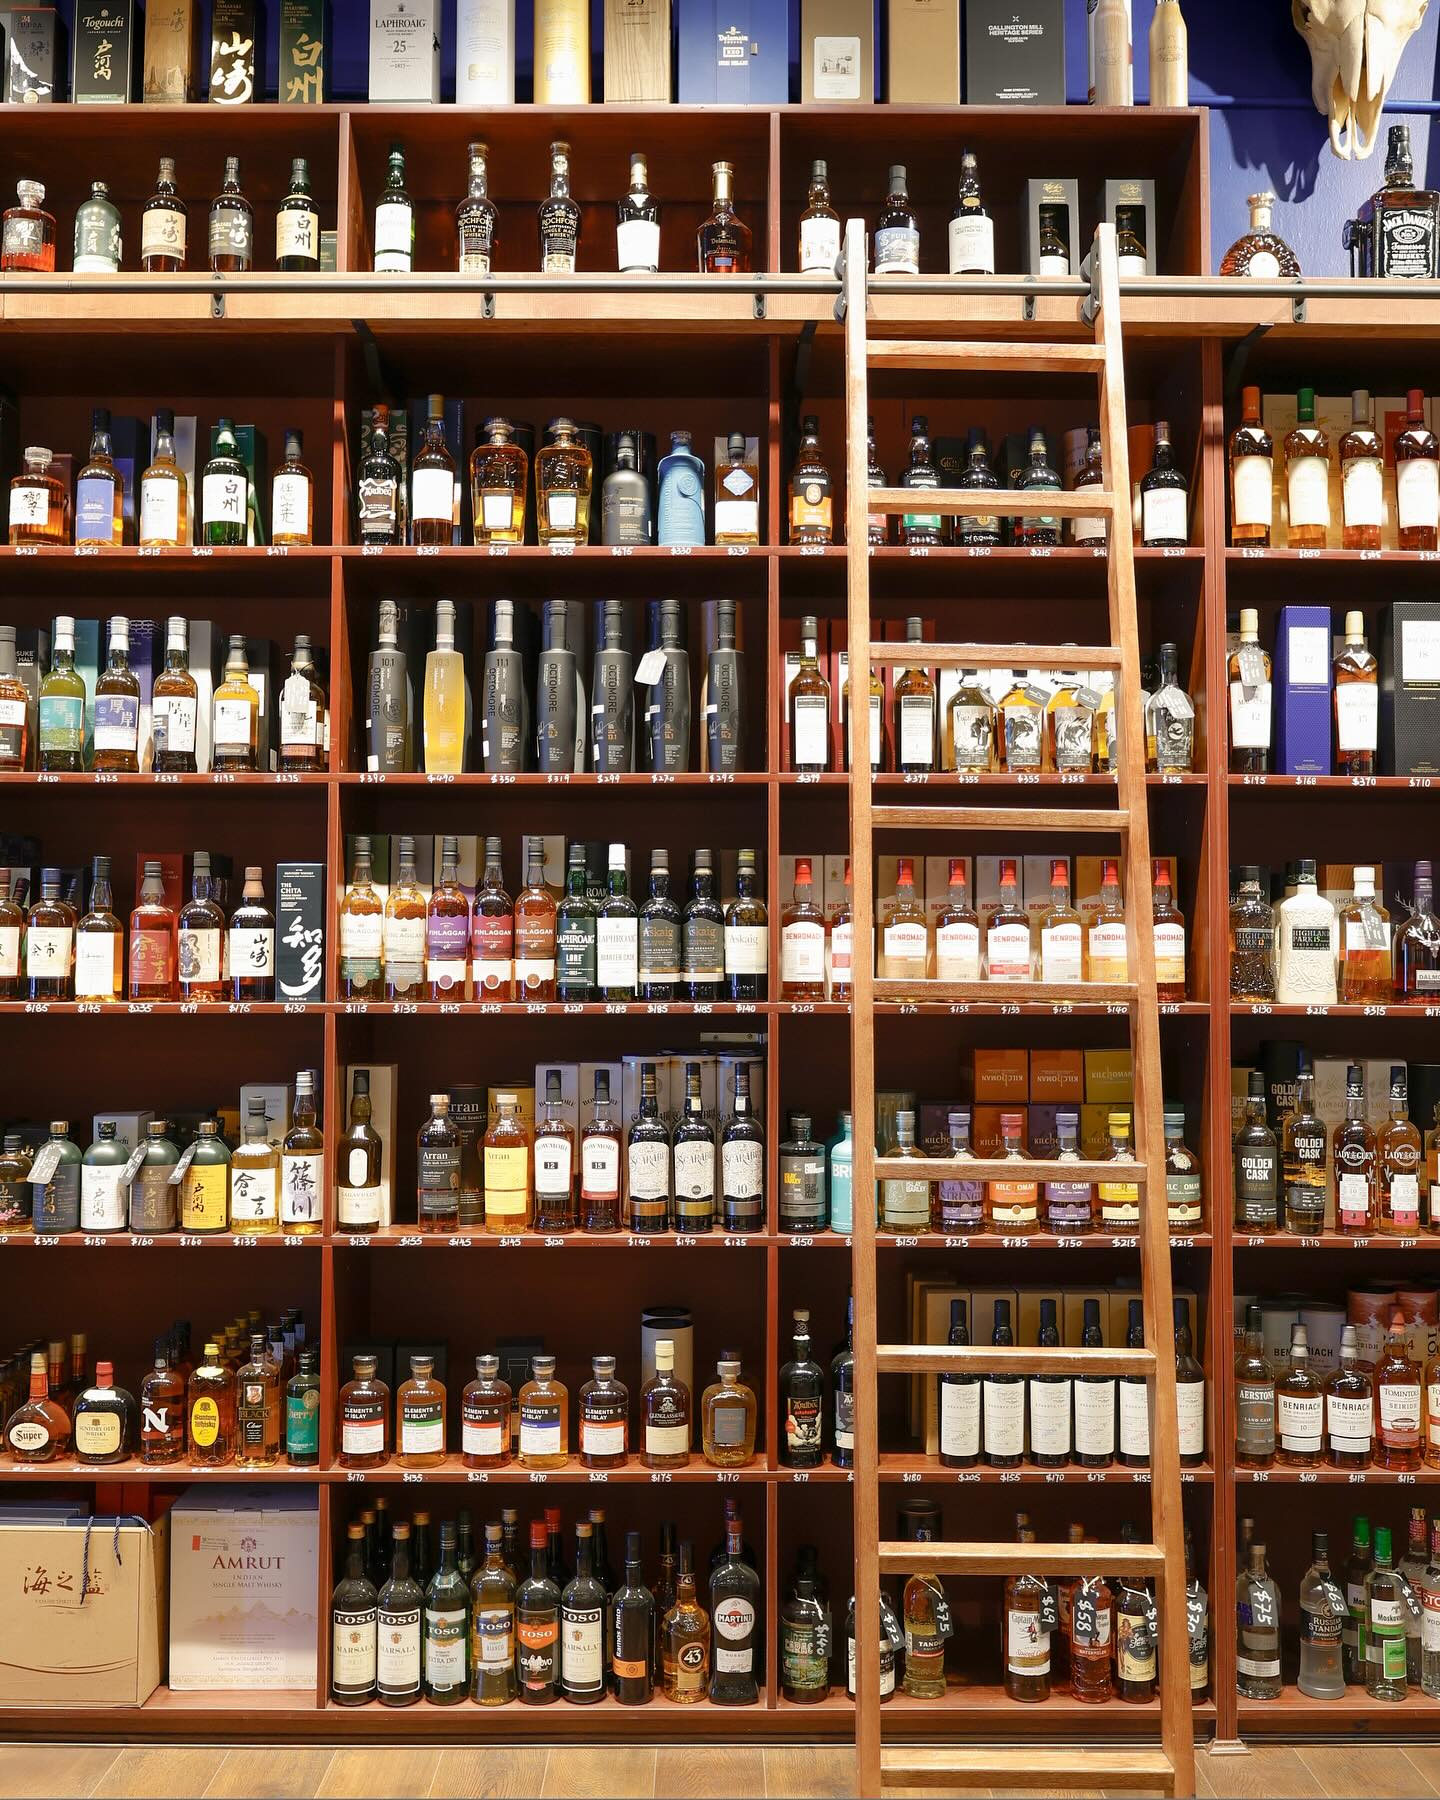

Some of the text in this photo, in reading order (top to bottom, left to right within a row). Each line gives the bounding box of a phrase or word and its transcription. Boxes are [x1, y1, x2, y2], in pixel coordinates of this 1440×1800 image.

[83, 15, 124, 31] Togouchi
[376, 19, 425, 29] LAPHROAIG
[393, 41, 407, 53] 25
[286, 33, 324, 105] 白州
[1382, 216, 1404, 232] JACK
[295, 214, 311, 250] 白州
[222, 479, 239, 515] 白州
[372, 667, 381, 717] OCTOMORE
[488, 667, 497, 717] OCTOMORE
[549, 663, 558, 713] OCTOMORE
[608, 664, 617, 714] OCTOMORE
[721, 664, 730, 714] OCTOMORE
[491, 774, 515, 784] $350
[1296, 777, 1316, 786] $168
[1352, 777, 1376, 787] $370
[1410, 778, 1430, 788] $710
[515, 928, 554, 936] FINLAGGAN
[556, 934, 595, 944] LAPHROAIG
[1292, 935, 1313, 944] PARK
[566, 953, 584, 962] LORE
[284, 1003, 305, 1013] $130
[345, 1003, 367, 1013] $115
[1252, 1005, 1272, 1014] $130
[1306, 1005, 1330, 1016] $215
[1364, 1006, 1386, 1016] $315
[1294, 1136, 1324, 1149] GOLDEN
[422, 1151, 448, 1160] Arran
[1299, 1147, 1321, 1160] CASK
[1241, 1157, 1273, 1169] GOLDEN
[1246, 1169, 1269, 1181] CASK
[738, 1184, 748, 1195] 10
[34, 1237, 59, 1246] $350
[85, 1238, 106, 1246] $150
[131, 1238, 153, 1246] $160
[180, 1238, 201, 1246] $160
[233, 1238, 256, 1246] $135
[285, 1238, 302, 1246] $85
[791, 1238, 813, 1247] $150
[896, 1239, 917, 1247] $150
[946, 1239, 968, 1248] $215
[1002, 1239, 1028, 1248] $185
[1058, 1239, 1082, 1249] $150
[1112, 1239, 1136, 1248] $215
[1168, 1239, 1193, 1248] $215
[1239, 1389, 1274, 1401] AERSTONE
[239, 1410, 269, 1418] BLACK
[142, 1407, 169, 1433] N
[194, 1421, 216, 1429] Whisky
[15, 1428, 42, 1443] Super
[958, 1474, 980, 1483] $205
[212, 1555, 285, 1570] AMRUT
[237, 1580, 255, 1588] MALT
[256, 1580, 283, 1588] WHISKY
[683, 1575, 693, 1584] 43
[1324, 1581, 1345, 1612] $63
[1402, 1585, 1420, 1615] $65
[1041, 1596, 1057, 1624] $69
[1252, 1590, 1273, 1626] $75
[335, 1612, 376, 1625] TOSO
[379, 1614, 418, 1625] TOSO
[561, 1611, 599, 1624] TOSO
[717, 1613, 752, 1623] MARTINI
[936, 1601, 950, 1632] $75
[1075, 1598, 1093, 1632] $58
[1187, 1600, 1203, 1633] $70
[478, 1621, 511, 1631] TOSO
[1313, 1617, 1342, 1627] RUSSIAN
[427, 1626, 460, 1636] TOSO
[883, 1613, 901, 1644] $72
[521, 1629, 553, 1639] TOSO
[814, 1623, 830, 1656] $140
[683, 1648, 701, 1663] 43
